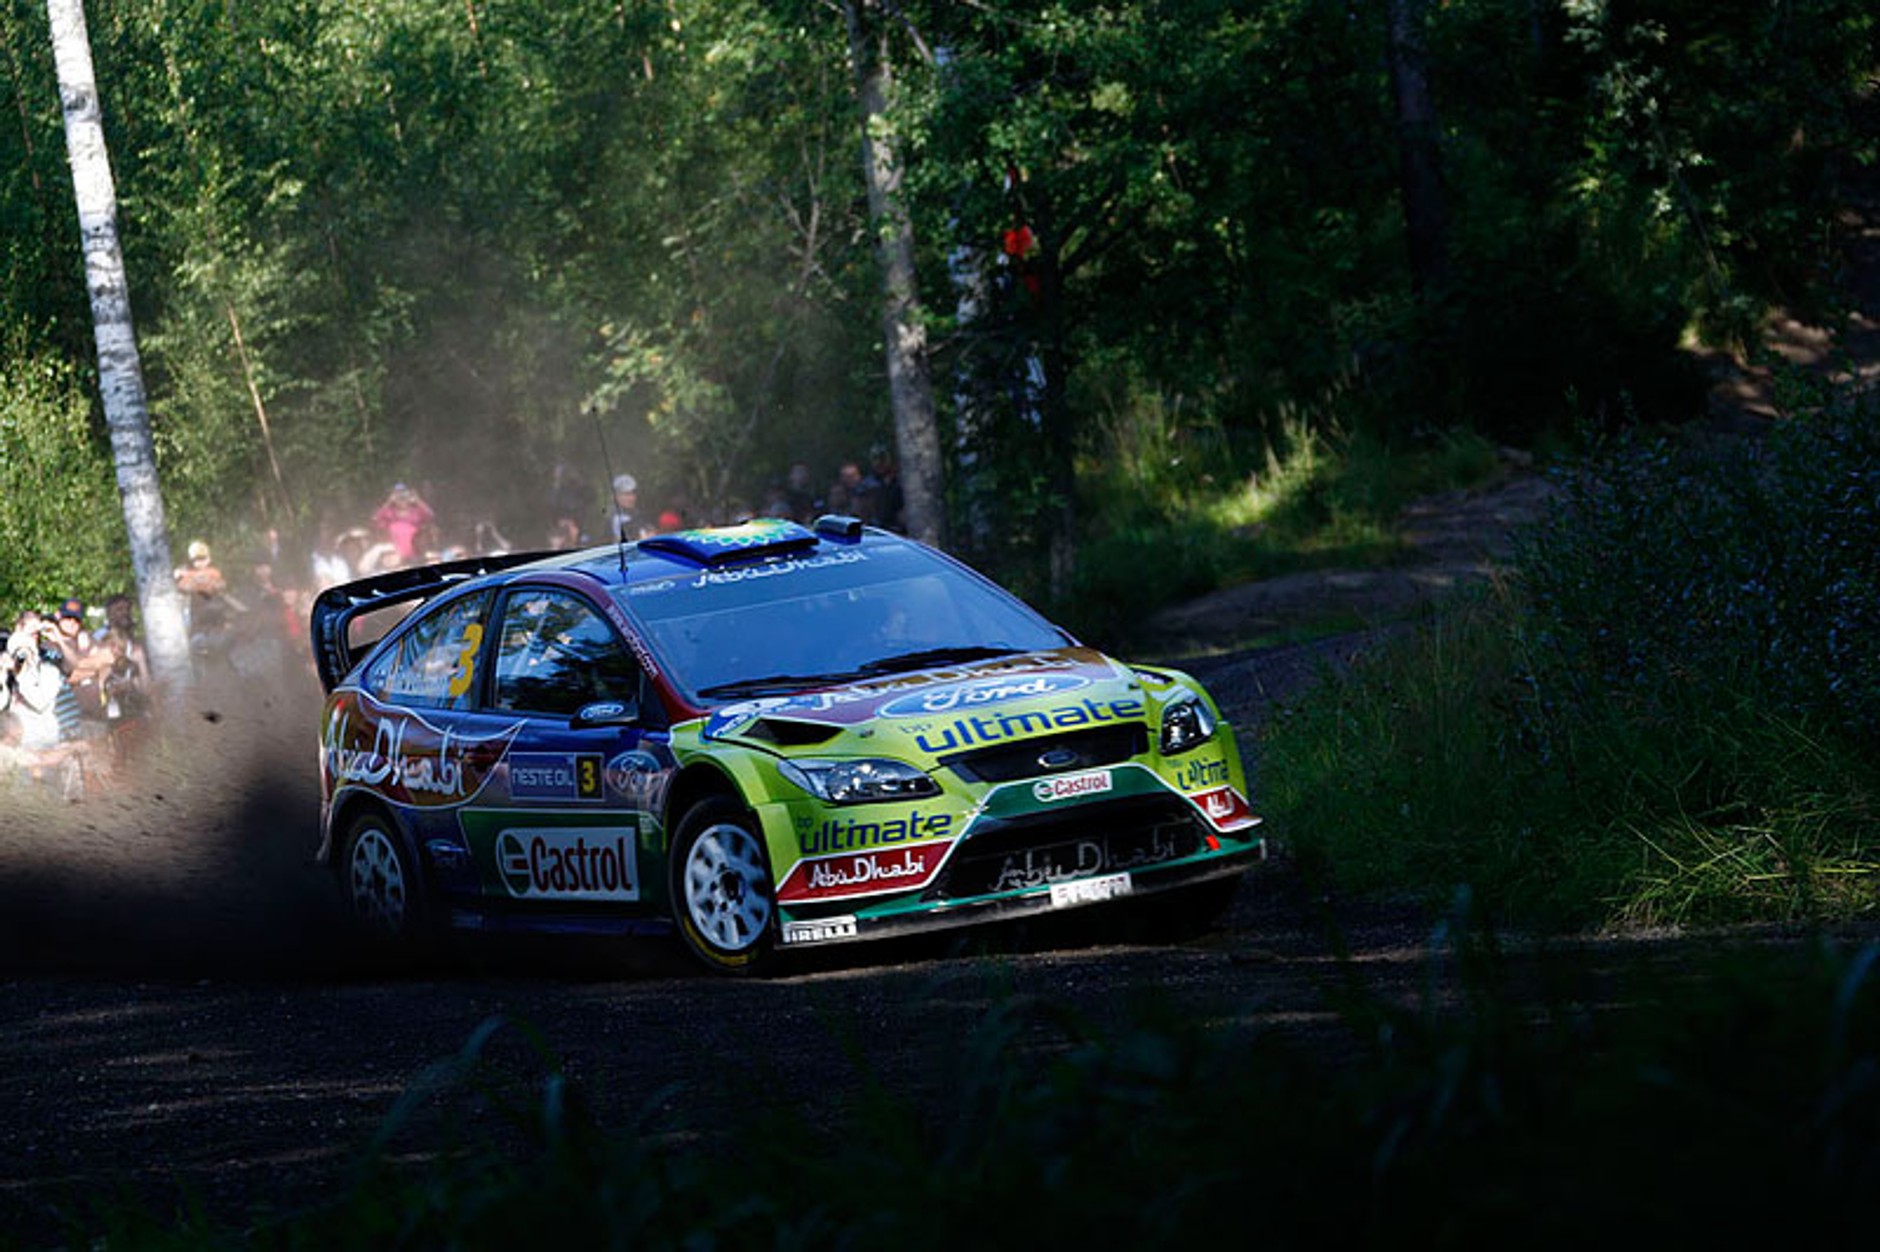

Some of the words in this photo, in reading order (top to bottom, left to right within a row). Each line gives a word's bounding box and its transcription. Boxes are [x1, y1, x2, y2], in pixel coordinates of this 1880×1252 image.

[449, 623, 483, 696] 3
[922, 677, 1058, 711] Ford
[916, 699, 1145, 753] ultimate
[581, 759, 596, 794] 3
[1054, 774, 1109, 796] Castrol
[800, 811, 953, 854] ultimate
[531, 836, 632, 892] Castrol
